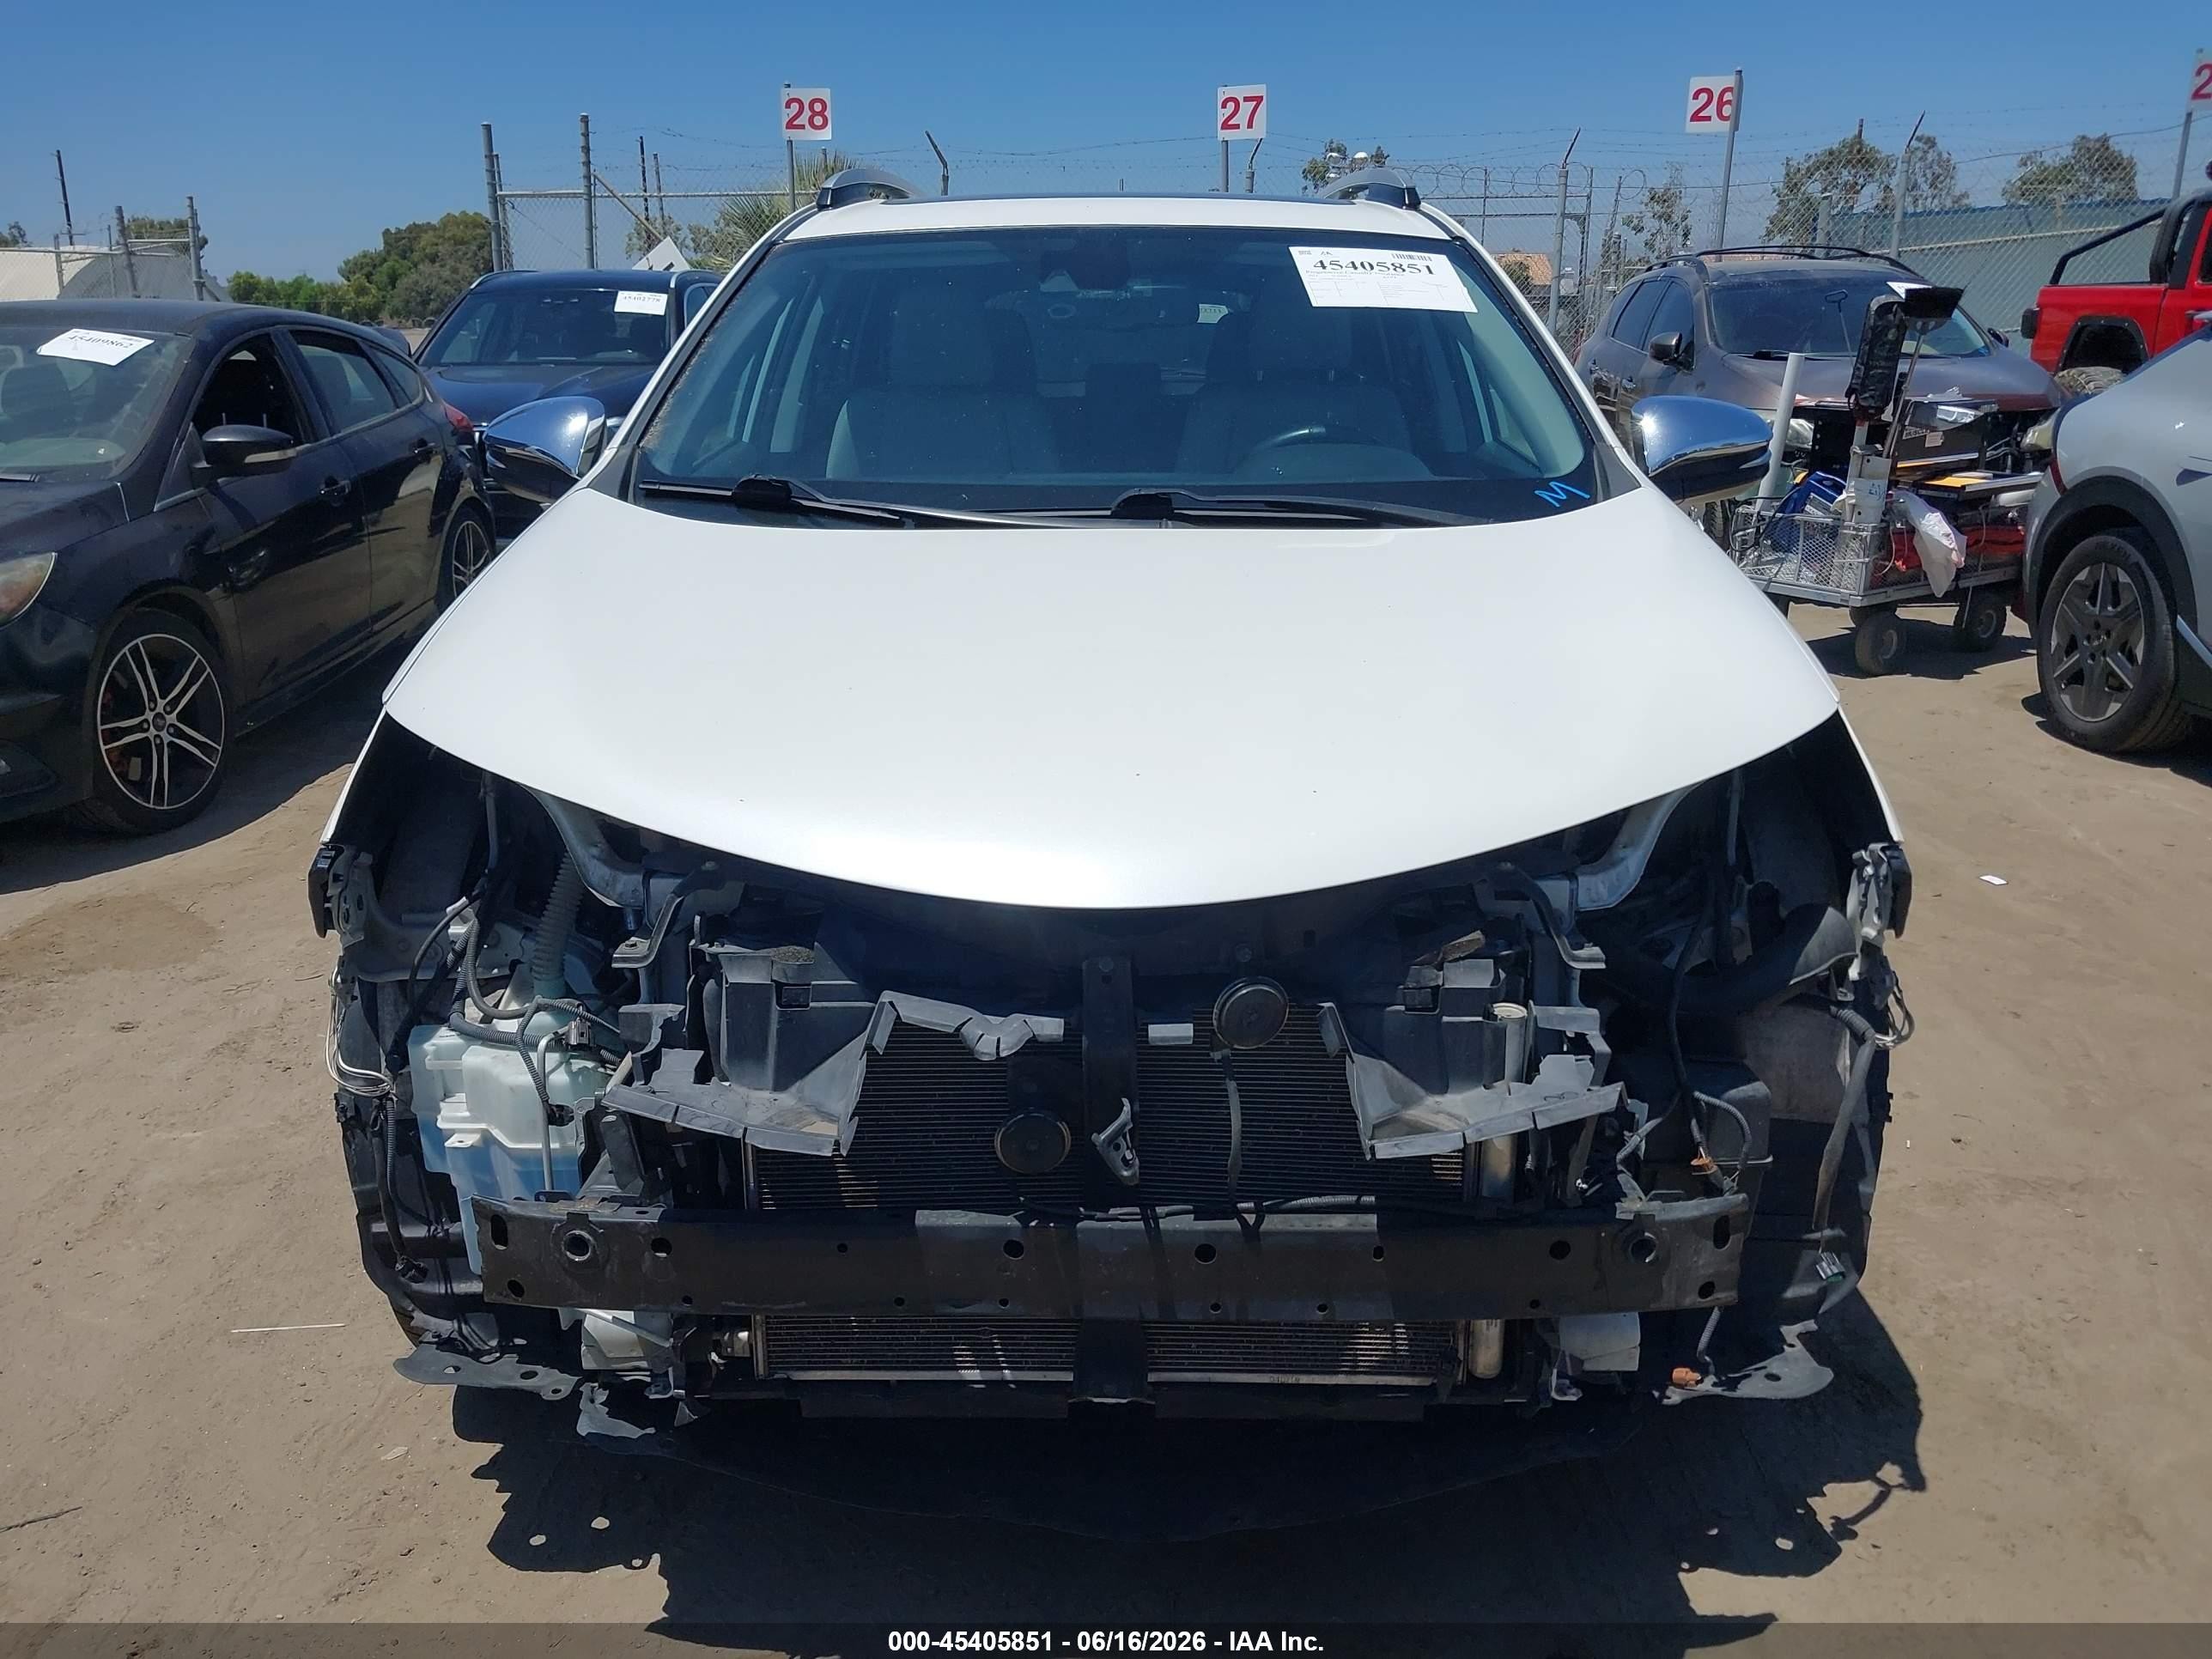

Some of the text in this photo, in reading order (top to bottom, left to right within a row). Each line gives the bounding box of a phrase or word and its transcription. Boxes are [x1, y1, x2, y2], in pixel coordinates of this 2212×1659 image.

[785, 97, 829, 131] 28
[1220, 95, 1264, 131] 27
[1690, 87, 1735, 123] 26
[1313, 258, 1436, 276] 45405851
[1534, 481, 1591, 507] M
